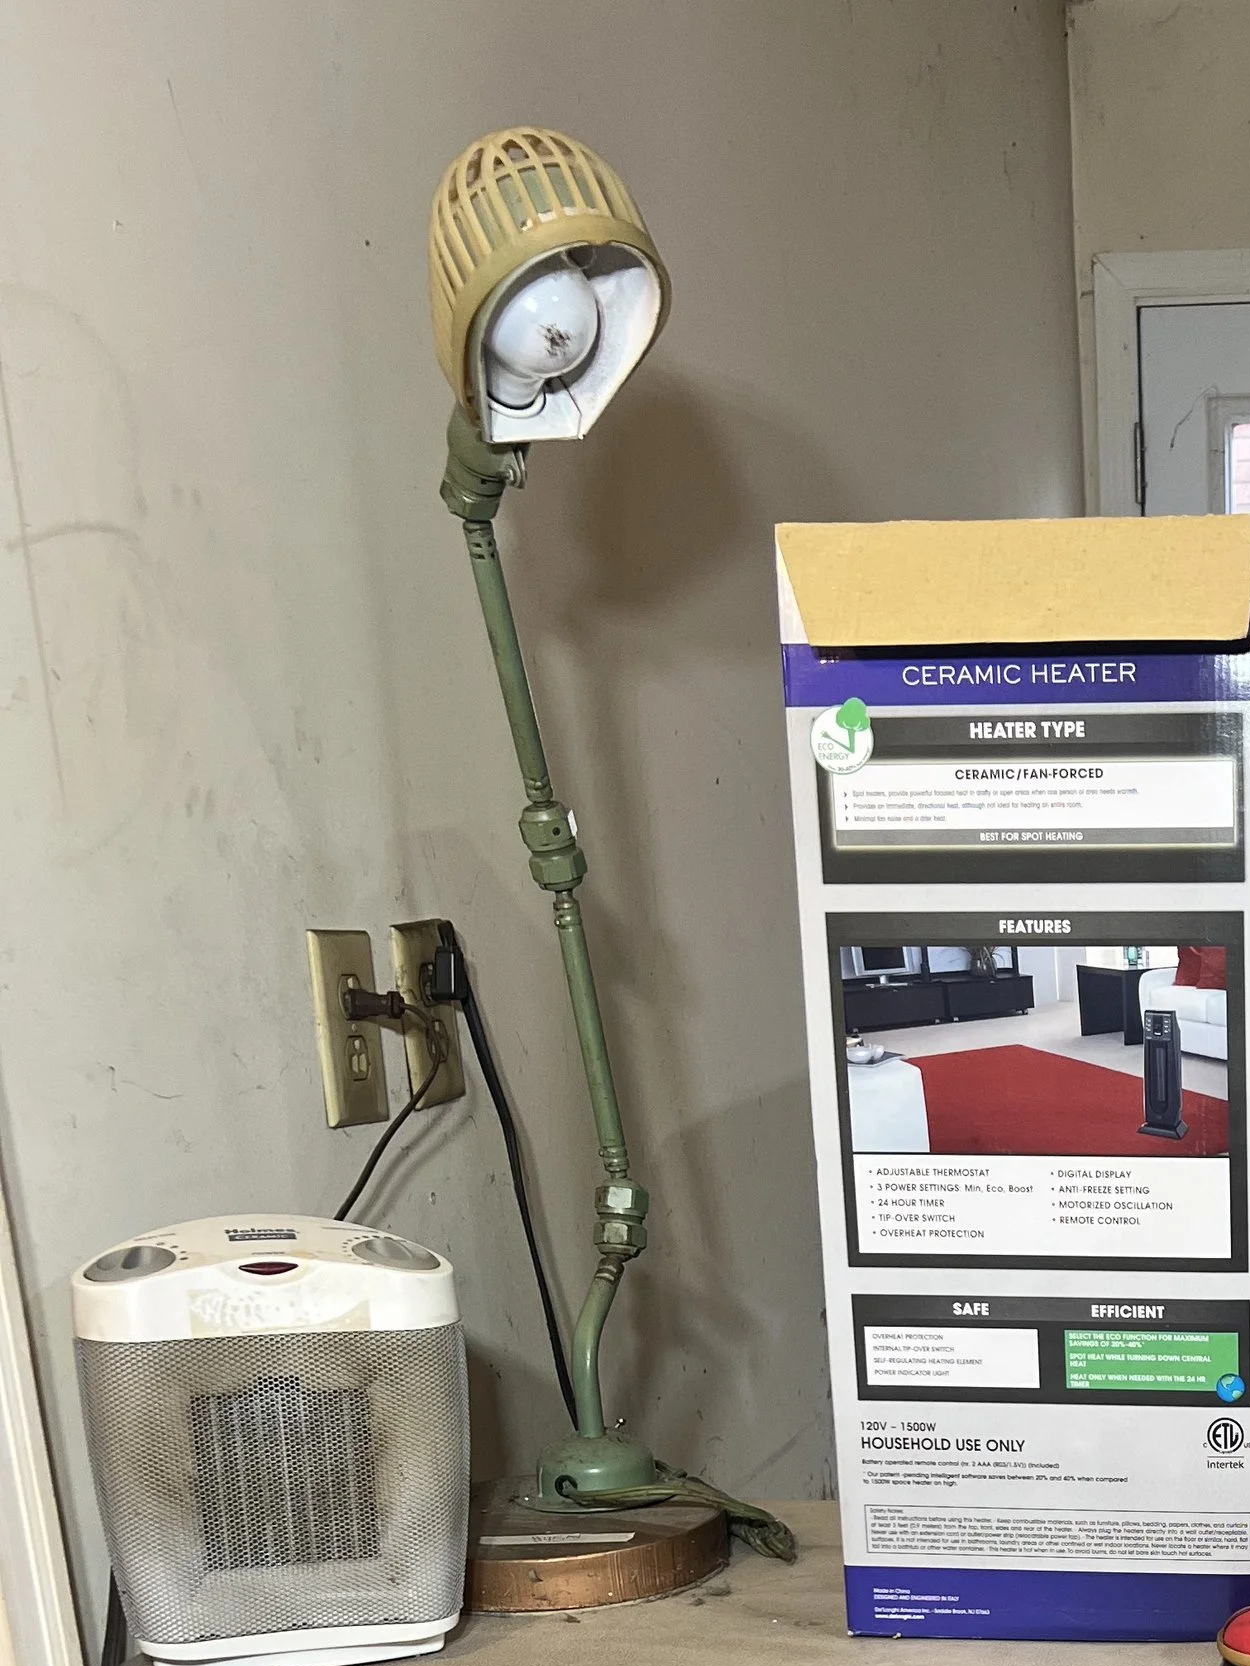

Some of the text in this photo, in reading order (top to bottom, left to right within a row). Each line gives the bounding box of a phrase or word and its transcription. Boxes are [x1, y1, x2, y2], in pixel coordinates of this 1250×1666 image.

[902, 663, 1137, 686] CERAMIC HEATER
[969, 721, 1085, 739] HEATER TYPE
[818, 743, 834, 751] ECO
[819, 752, 849, 761] ENERGY
[955, 768, 1104, 780] CERAMIC/FAN-FORCED
[980, 832, 1083, 841] BEST FOR SPOT HEATING
[998, 919, 1071, 934] FEATURES
[877, 1168, 929, 1176] ADJUSTABLE
[1058, 1170, 1092, 1178] DIGITAL
[886, 1184, 916, 1192] POWER
[965, 1185, 983, 1193] Min,
[1009, 1185, 1033, 1193] Boost
[1059, 1186, 1112, 1194] ANTI-FREEZE
[1059, 1201, 1173, 1210] MOTORIZED OSCILLATION
[879, 1214, 955, 1223] TIP-OVER SWITCH
[1060, 1216, 1140, 1225] REMOTE CONTROL
[880, 1229, 984, 1238] OVERHEAT PROTECTION
[953, 1302, 990, 1316] SAFE
[1091, 1304, 1165, 1319] EFFICIENT
[861, 1422, 887, 1430] 120V
[901, 1422, 936, 1432] 1500W
[1212, 1423, 1239, 1449] ETL
[861, 1436, 1026, 1452] HOUSEHOLD USE ONLY
[1207, 1460, 1244, 1469] Intertek
